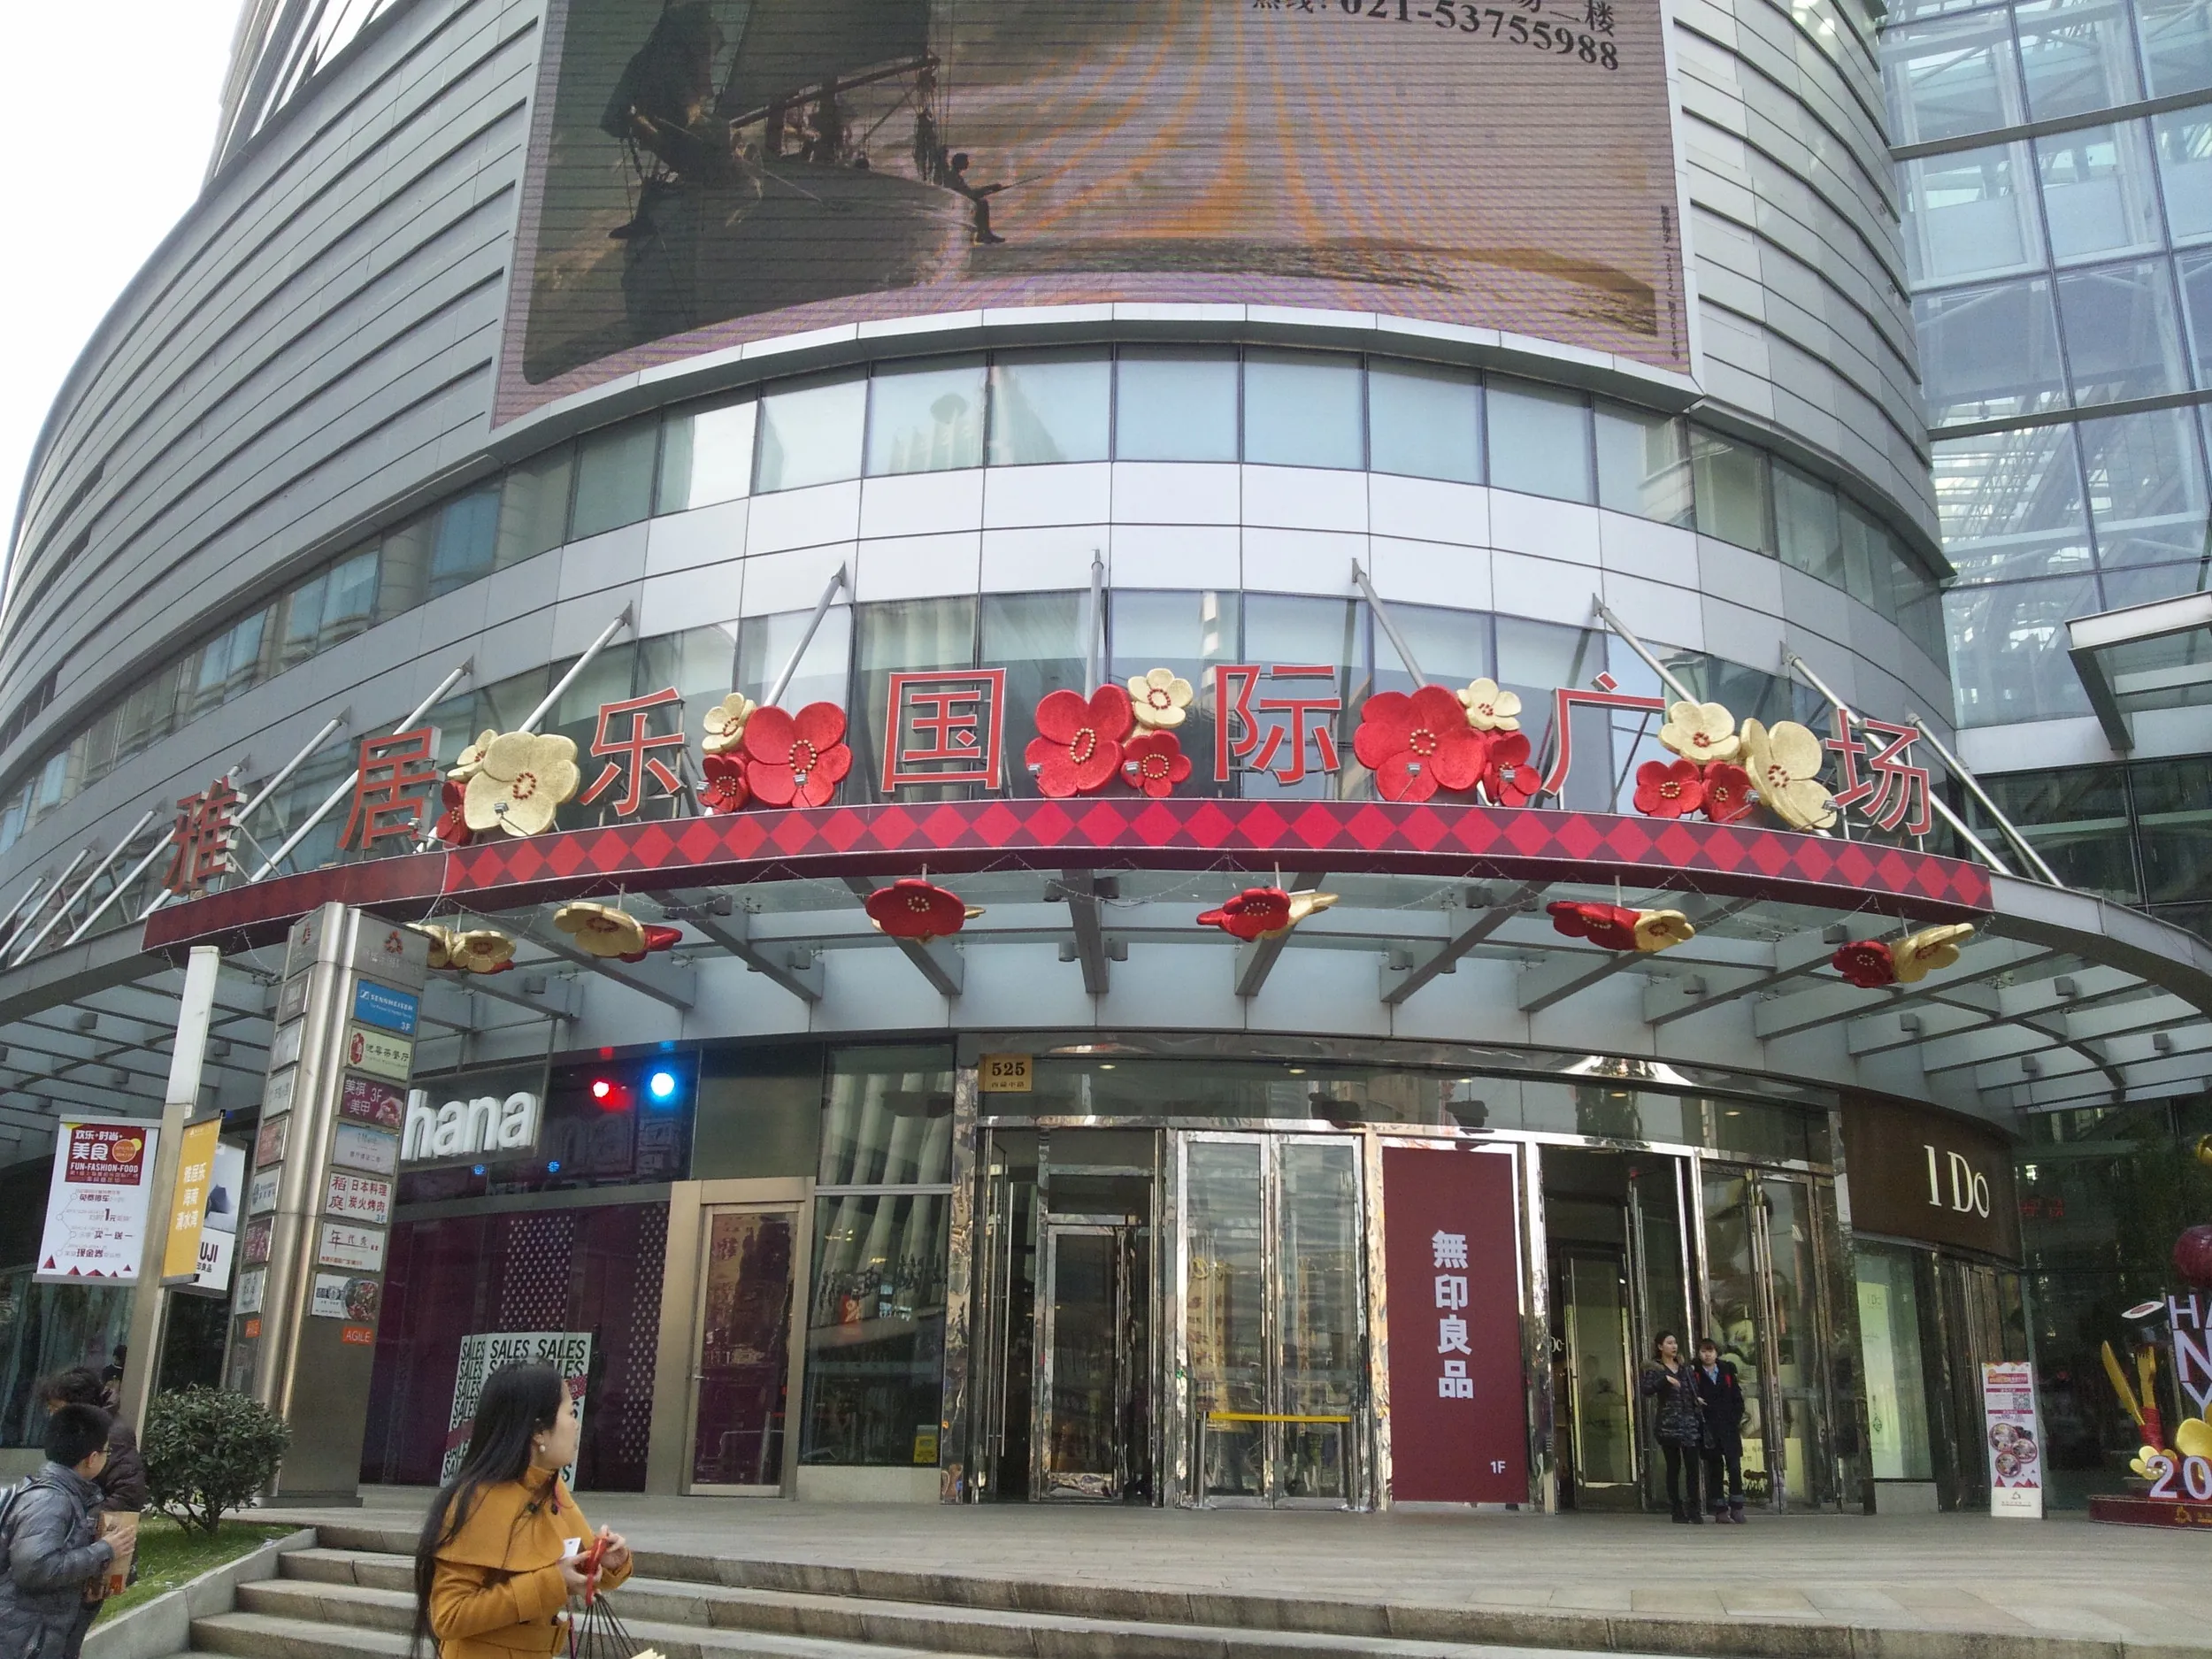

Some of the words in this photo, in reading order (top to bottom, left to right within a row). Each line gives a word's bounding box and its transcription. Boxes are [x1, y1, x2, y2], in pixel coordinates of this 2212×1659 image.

[370, 994, 413, 1011] SENNHEISER
[400, 1021, 411, 1032] 3F
[992, 1062, 1025, 1077] 525
[370, 1087, 383, 1102] 3F
[349, 1098, 371, 1117] 美甲
[400, 1089, 541, 1162] hana
[72, 1142, 109, 1161] 美食
[350, 1179, 388, 1197] 日本料理
[1924, 1144, 1942, 1207] I
[1947, 1150, 1990, 1218] Do
[348, 1195, 386, 1213] 炭火烤肉
[200, 1241, 219, 1263] UJI
[1432, 1230, 1474, 1399] 無印良品
[346, 1329, 372, 1343] AGILE
[461, 1340, 486, 1361] SALES
[489, 1340, 530, 1360] SALES
[535, 1339, 587, 1360] SALES
[458, 1360, 483, 1380] SALES
[1490, 1461, 1506, 1474] 1F
